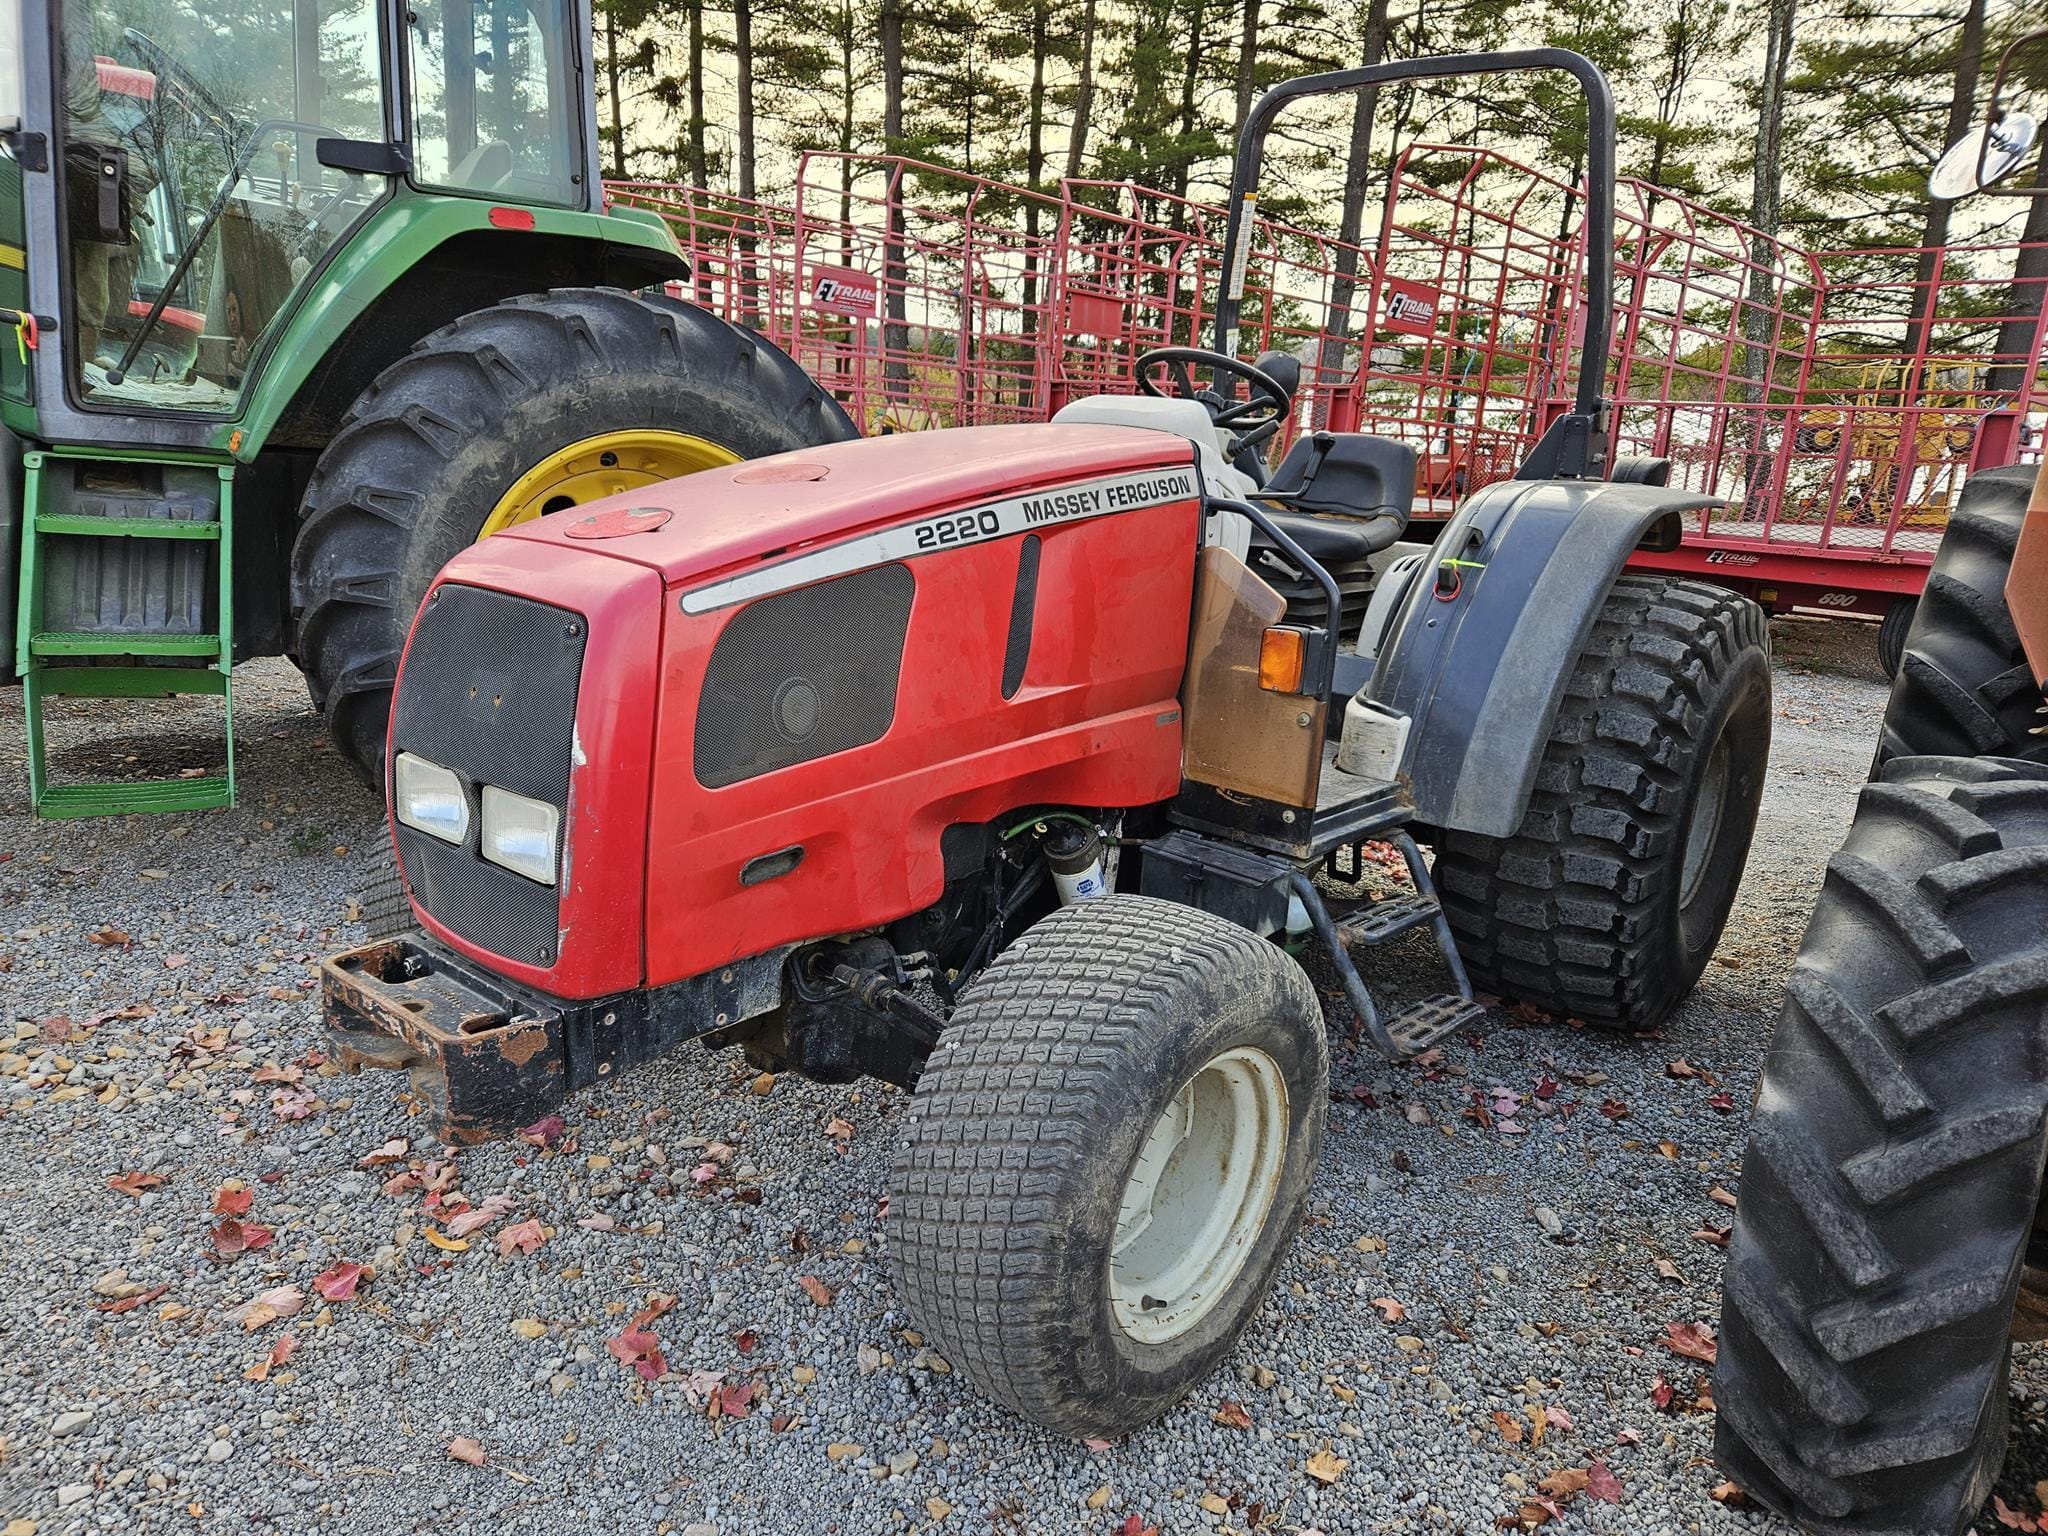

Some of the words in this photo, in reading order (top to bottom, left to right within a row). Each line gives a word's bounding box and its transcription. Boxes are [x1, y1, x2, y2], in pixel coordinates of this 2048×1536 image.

[835, 285, 875, 301] TRAIL
[1403, 299, 1434, 317] TRAIL
[915, 510, 1000, 549] 2220
[1022, 490, 1102, 523] MASSEY
[1106, 475, 1192, 508] FERGUSON
[1724, 553, 1760, 563] TRAIL
[1818, 593, 1857, 607] 890
